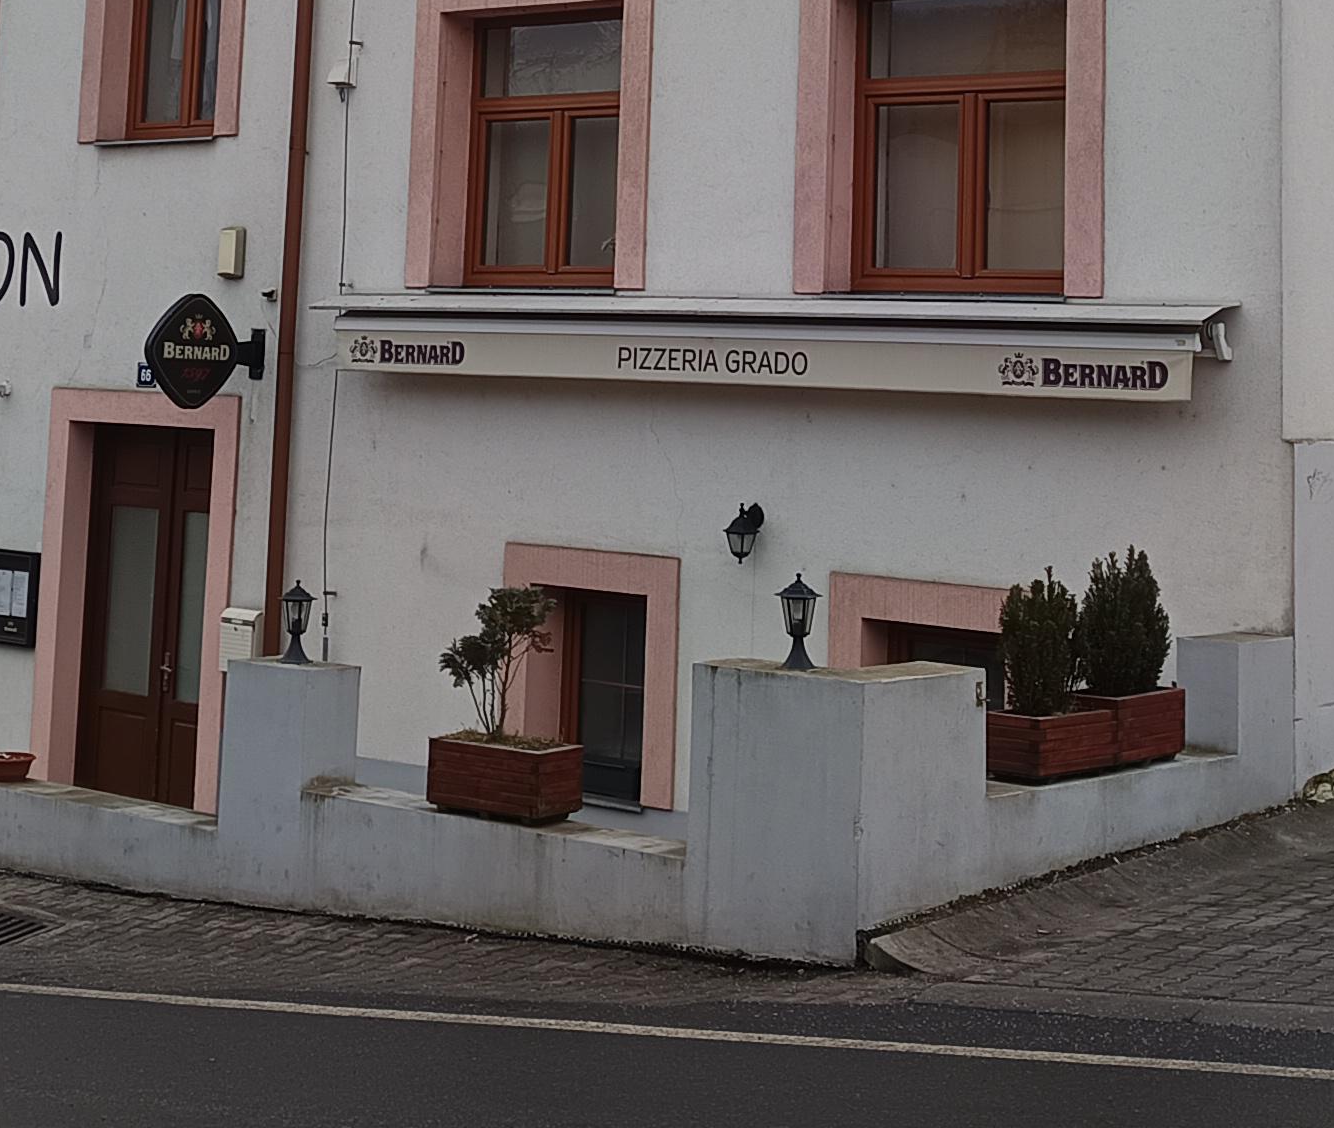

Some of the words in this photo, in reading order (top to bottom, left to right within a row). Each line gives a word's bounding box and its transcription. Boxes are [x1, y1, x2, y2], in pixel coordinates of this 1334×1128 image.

[617, 346, 719, 372] PIZZERIA
[725, 349, 808, 376] GRADO
[140, 369, 152, 382] 66
